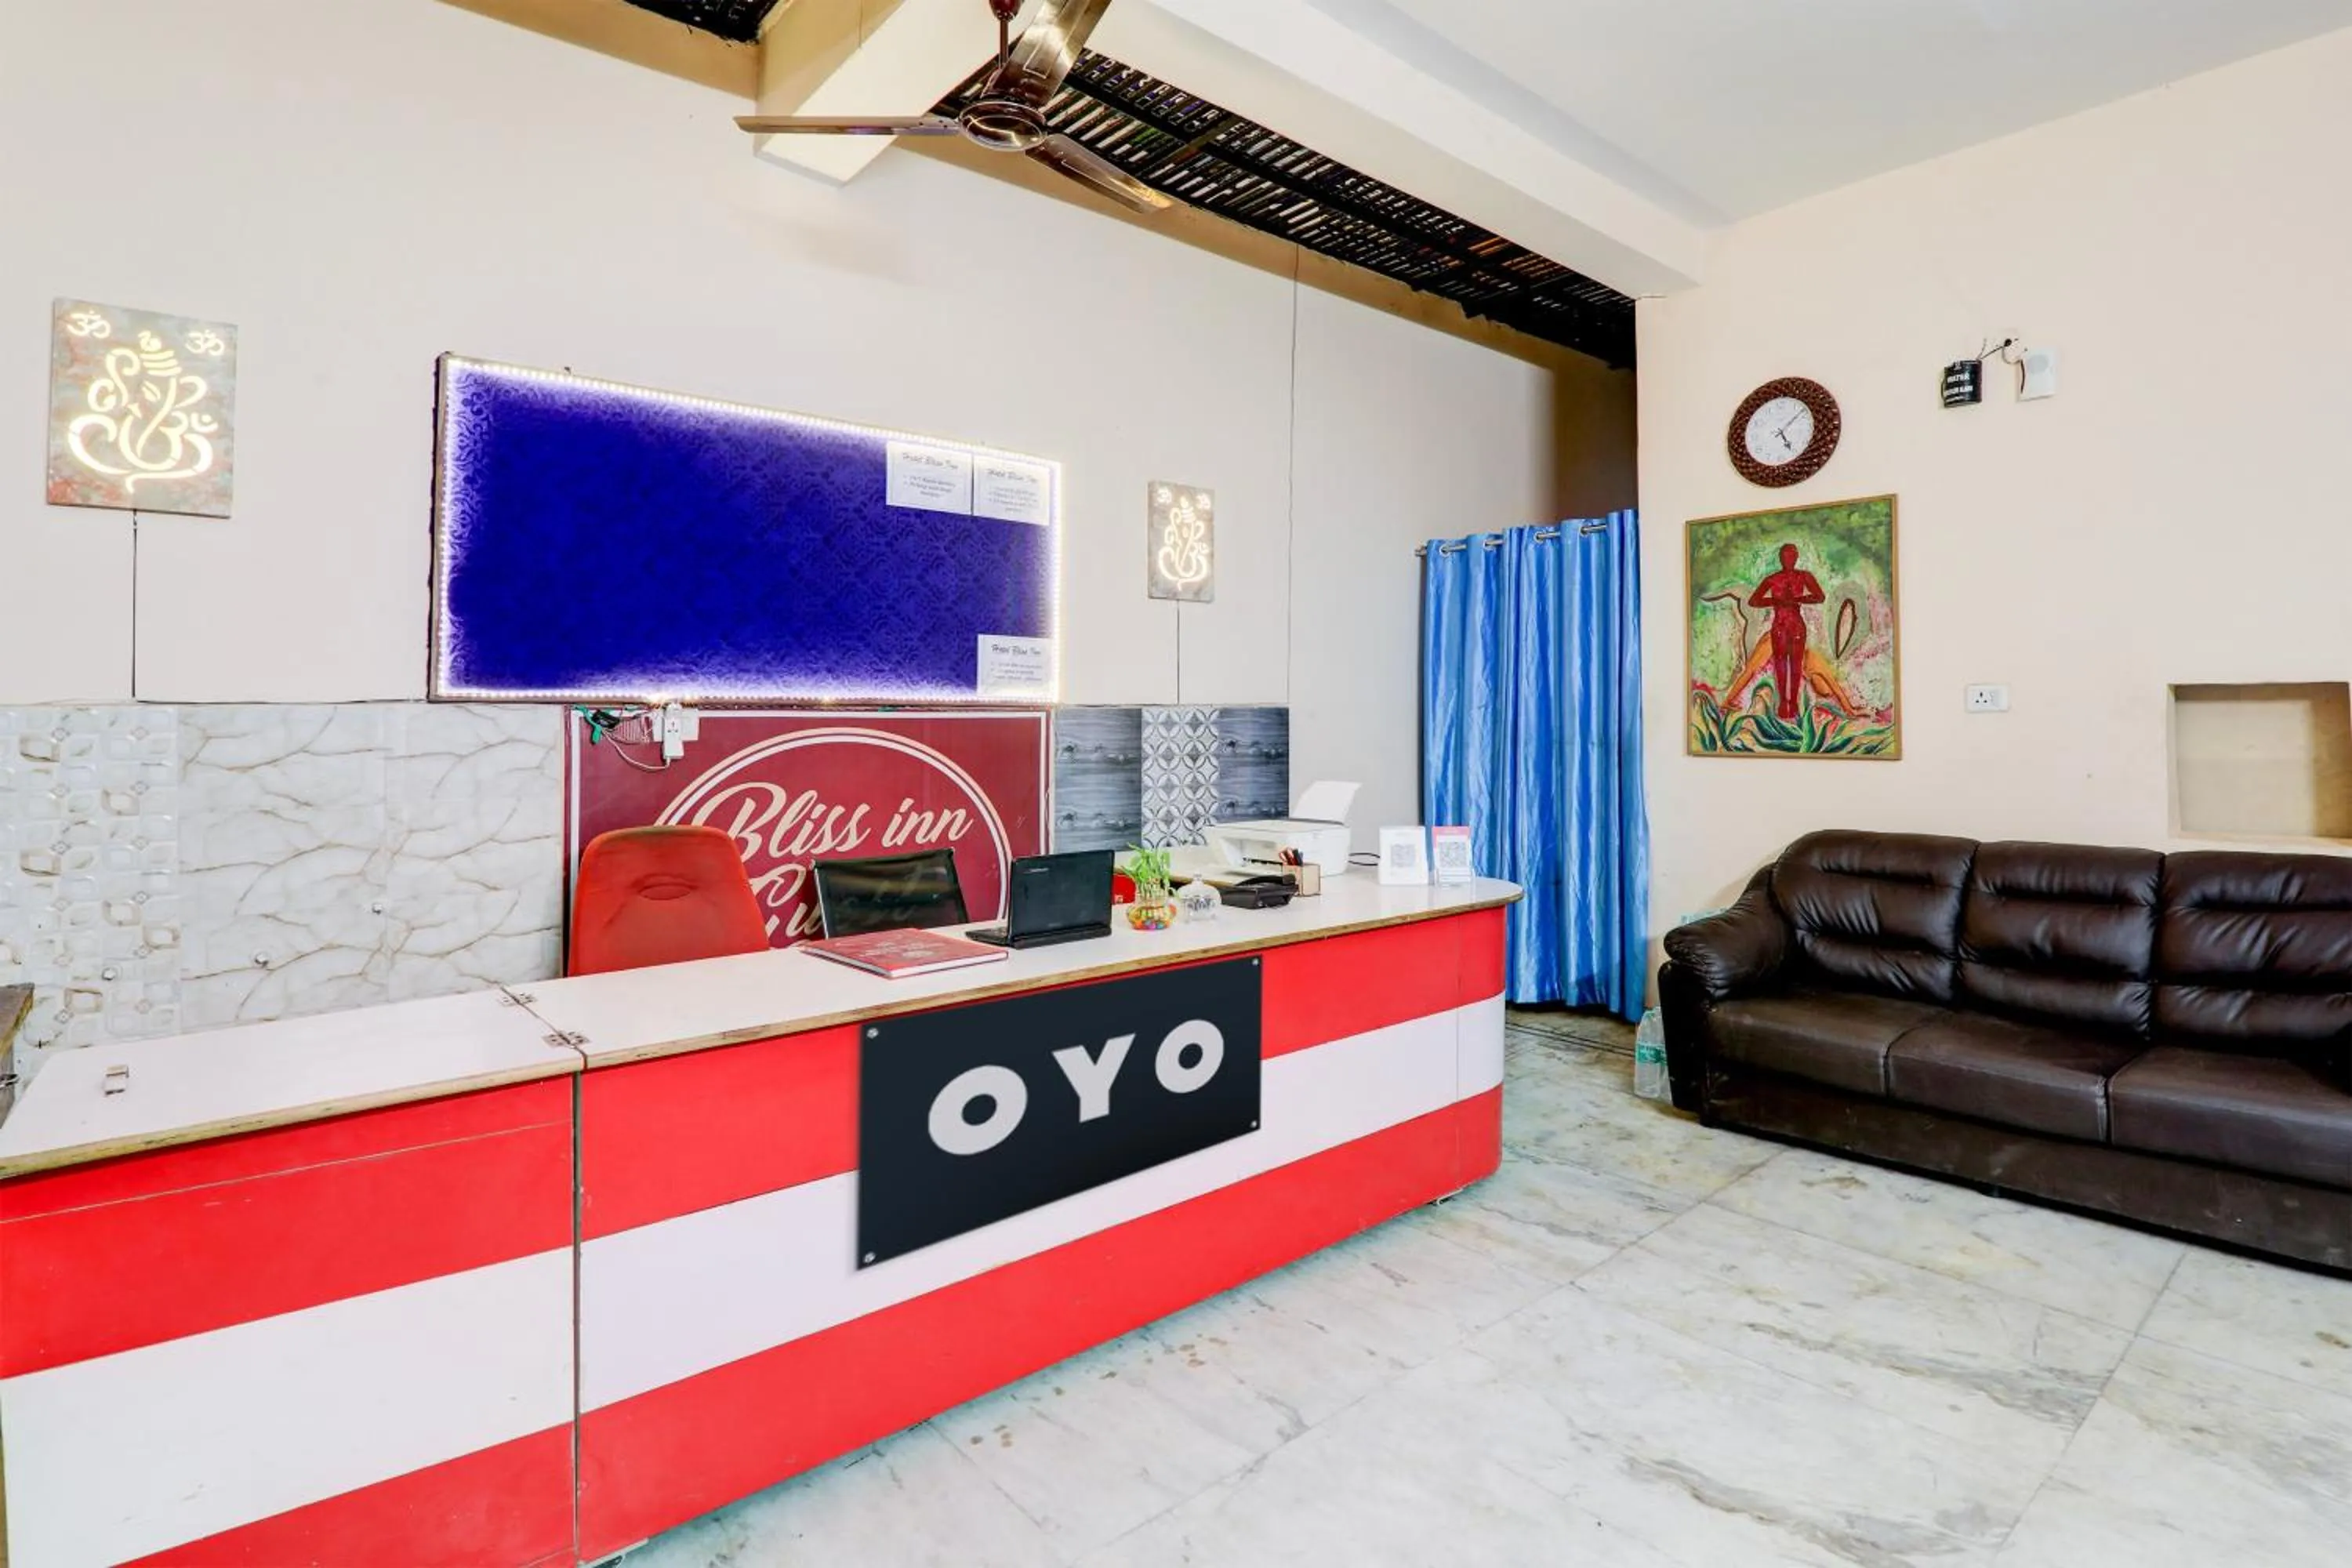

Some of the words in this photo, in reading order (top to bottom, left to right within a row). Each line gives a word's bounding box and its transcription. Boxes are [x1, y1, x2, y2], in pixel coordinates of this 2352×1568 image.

[691, 782, 871, 863] Bliss
[881, 797, 973, 848] inn
[927, 1018, 1225, 1156] OYO
